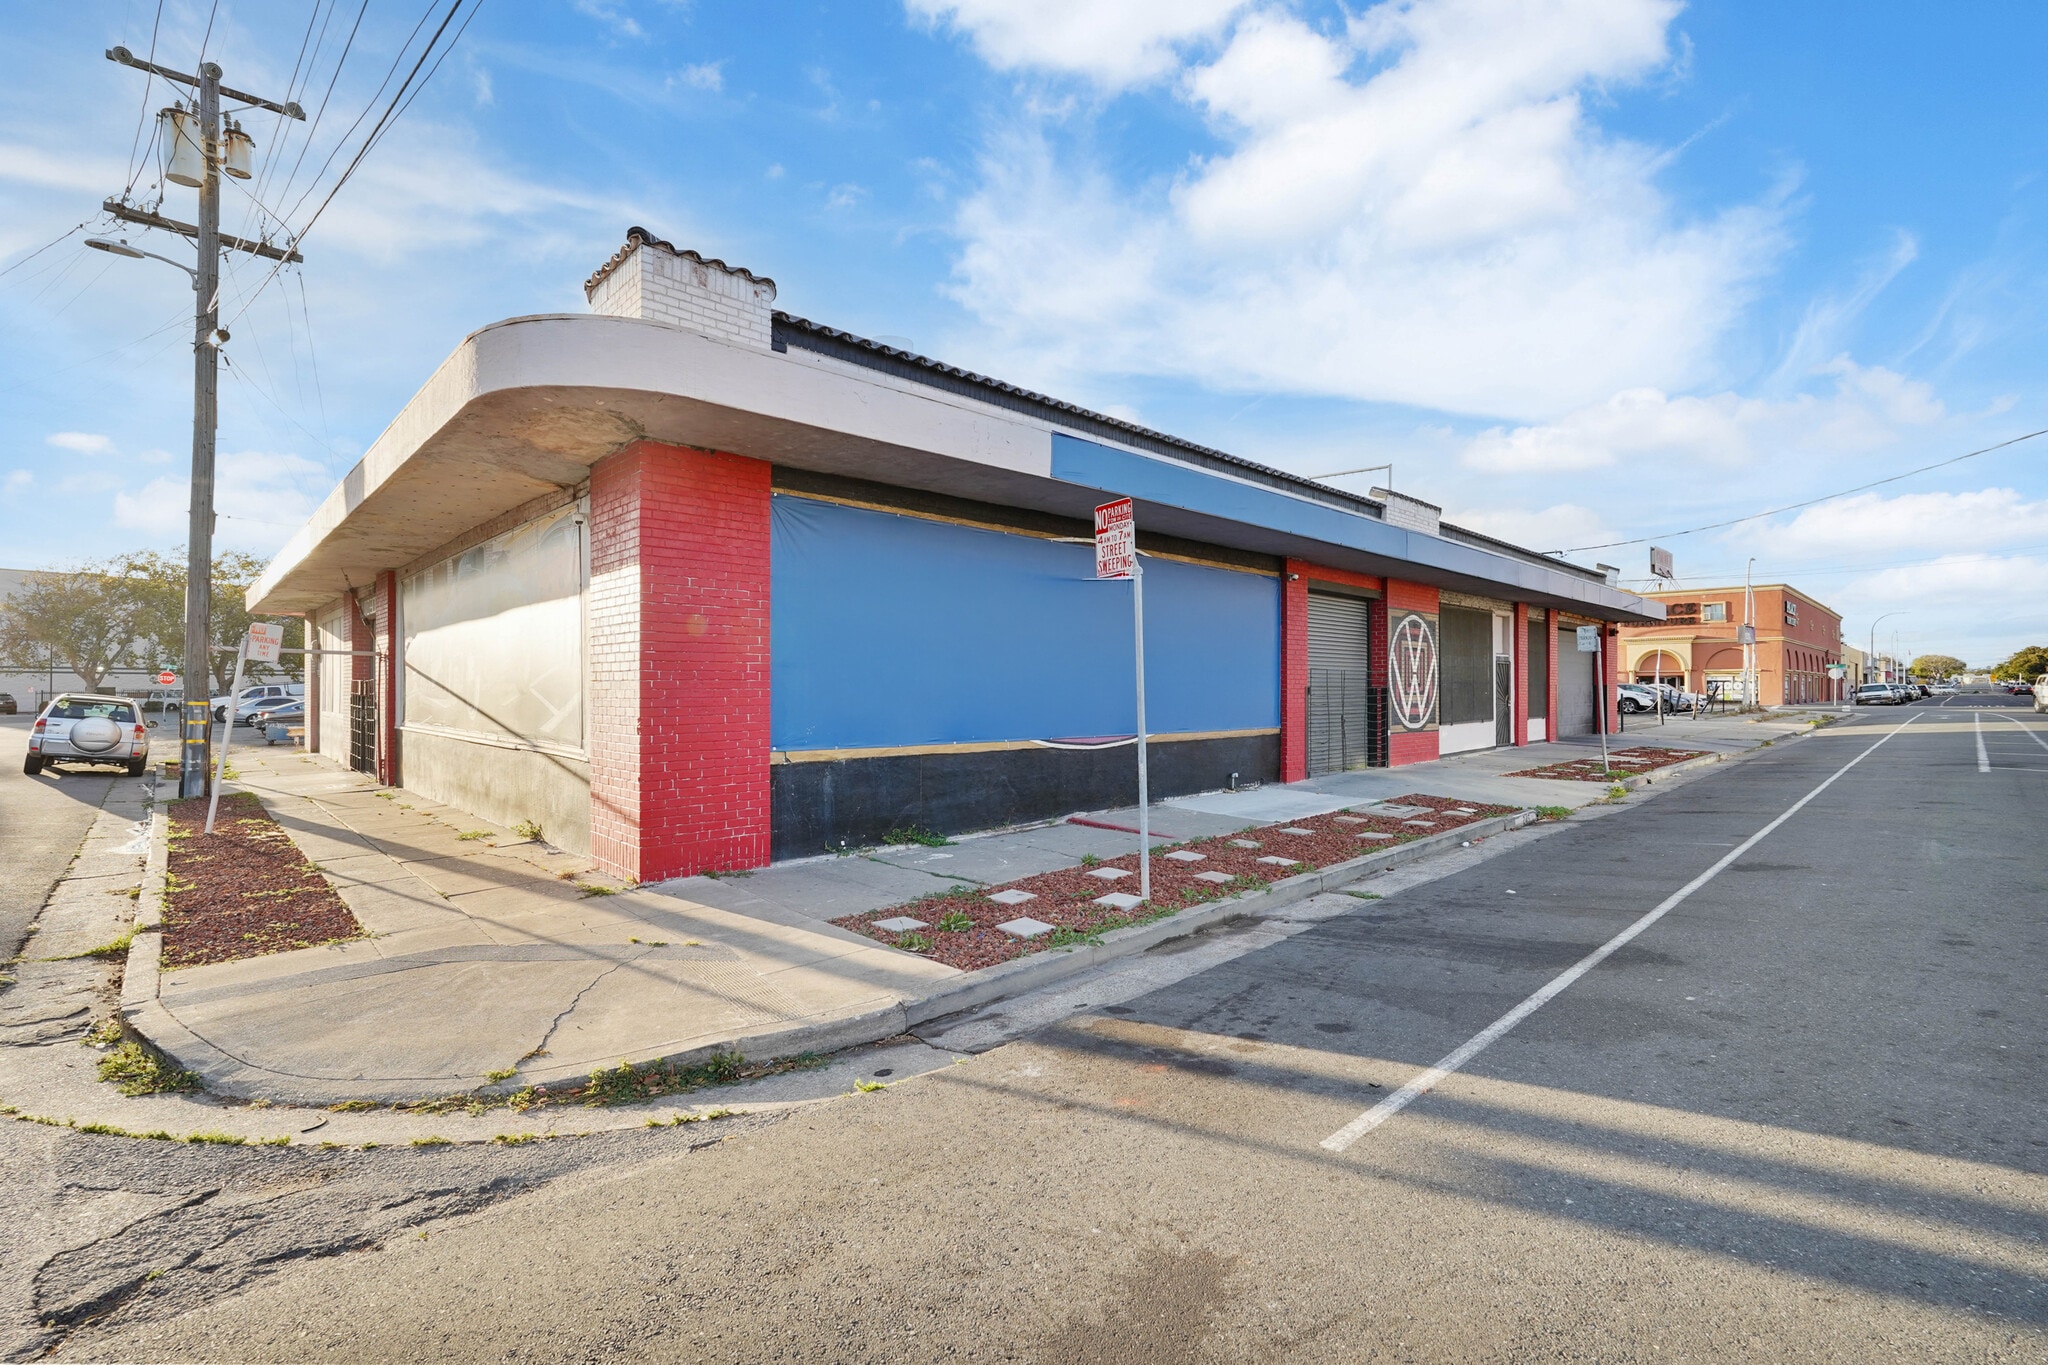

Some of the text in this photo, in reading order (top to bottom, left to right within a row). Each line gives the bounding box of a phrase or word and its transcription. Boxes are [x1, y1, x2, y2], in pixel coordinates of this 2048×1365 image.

[1095, 502, 1131, 530] NO PARKING
[1109, 521, 1130, 531] MONDAY
[1102, 541, 1126, 558] STREET
[1098, 554, 1132, 573] SWEEPING
[251, 635, 279, 645] PARKING
